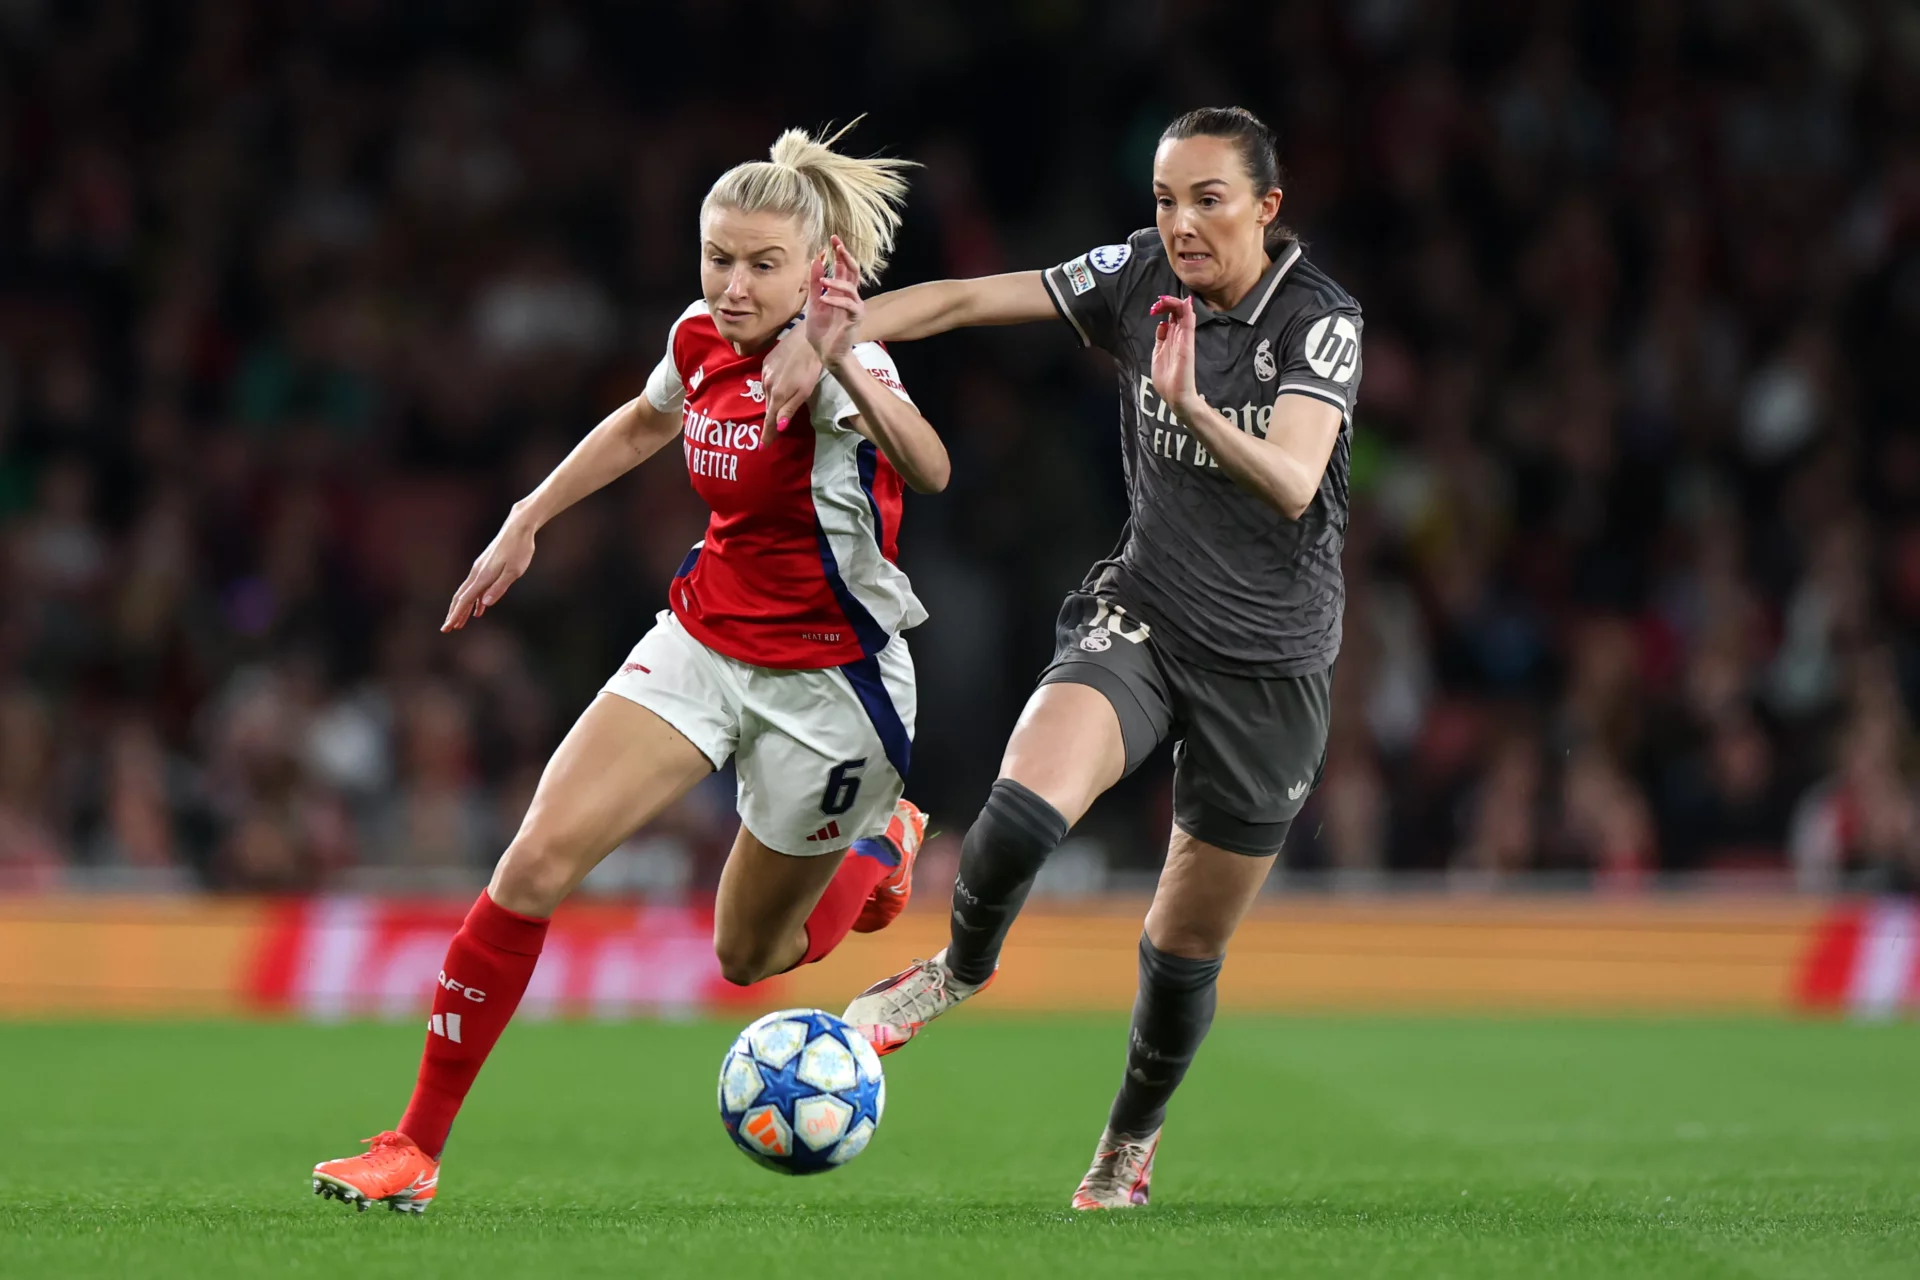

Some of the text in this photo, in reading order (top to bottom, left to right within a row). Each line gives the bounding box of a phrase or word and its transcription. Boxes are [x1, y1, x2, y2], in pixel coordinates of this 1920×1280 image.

[1071, 263, 1089, 291] ATION
[1311, 314, 1357, 380] hp
[1139, 374, 1274, 436] Eate
[1153, 427, 1188, 461] FLY
[693, 447, 738, 482] BETTER
[819, 757, 868, 816] 6
[438, 969, 486, 1003] AFC
